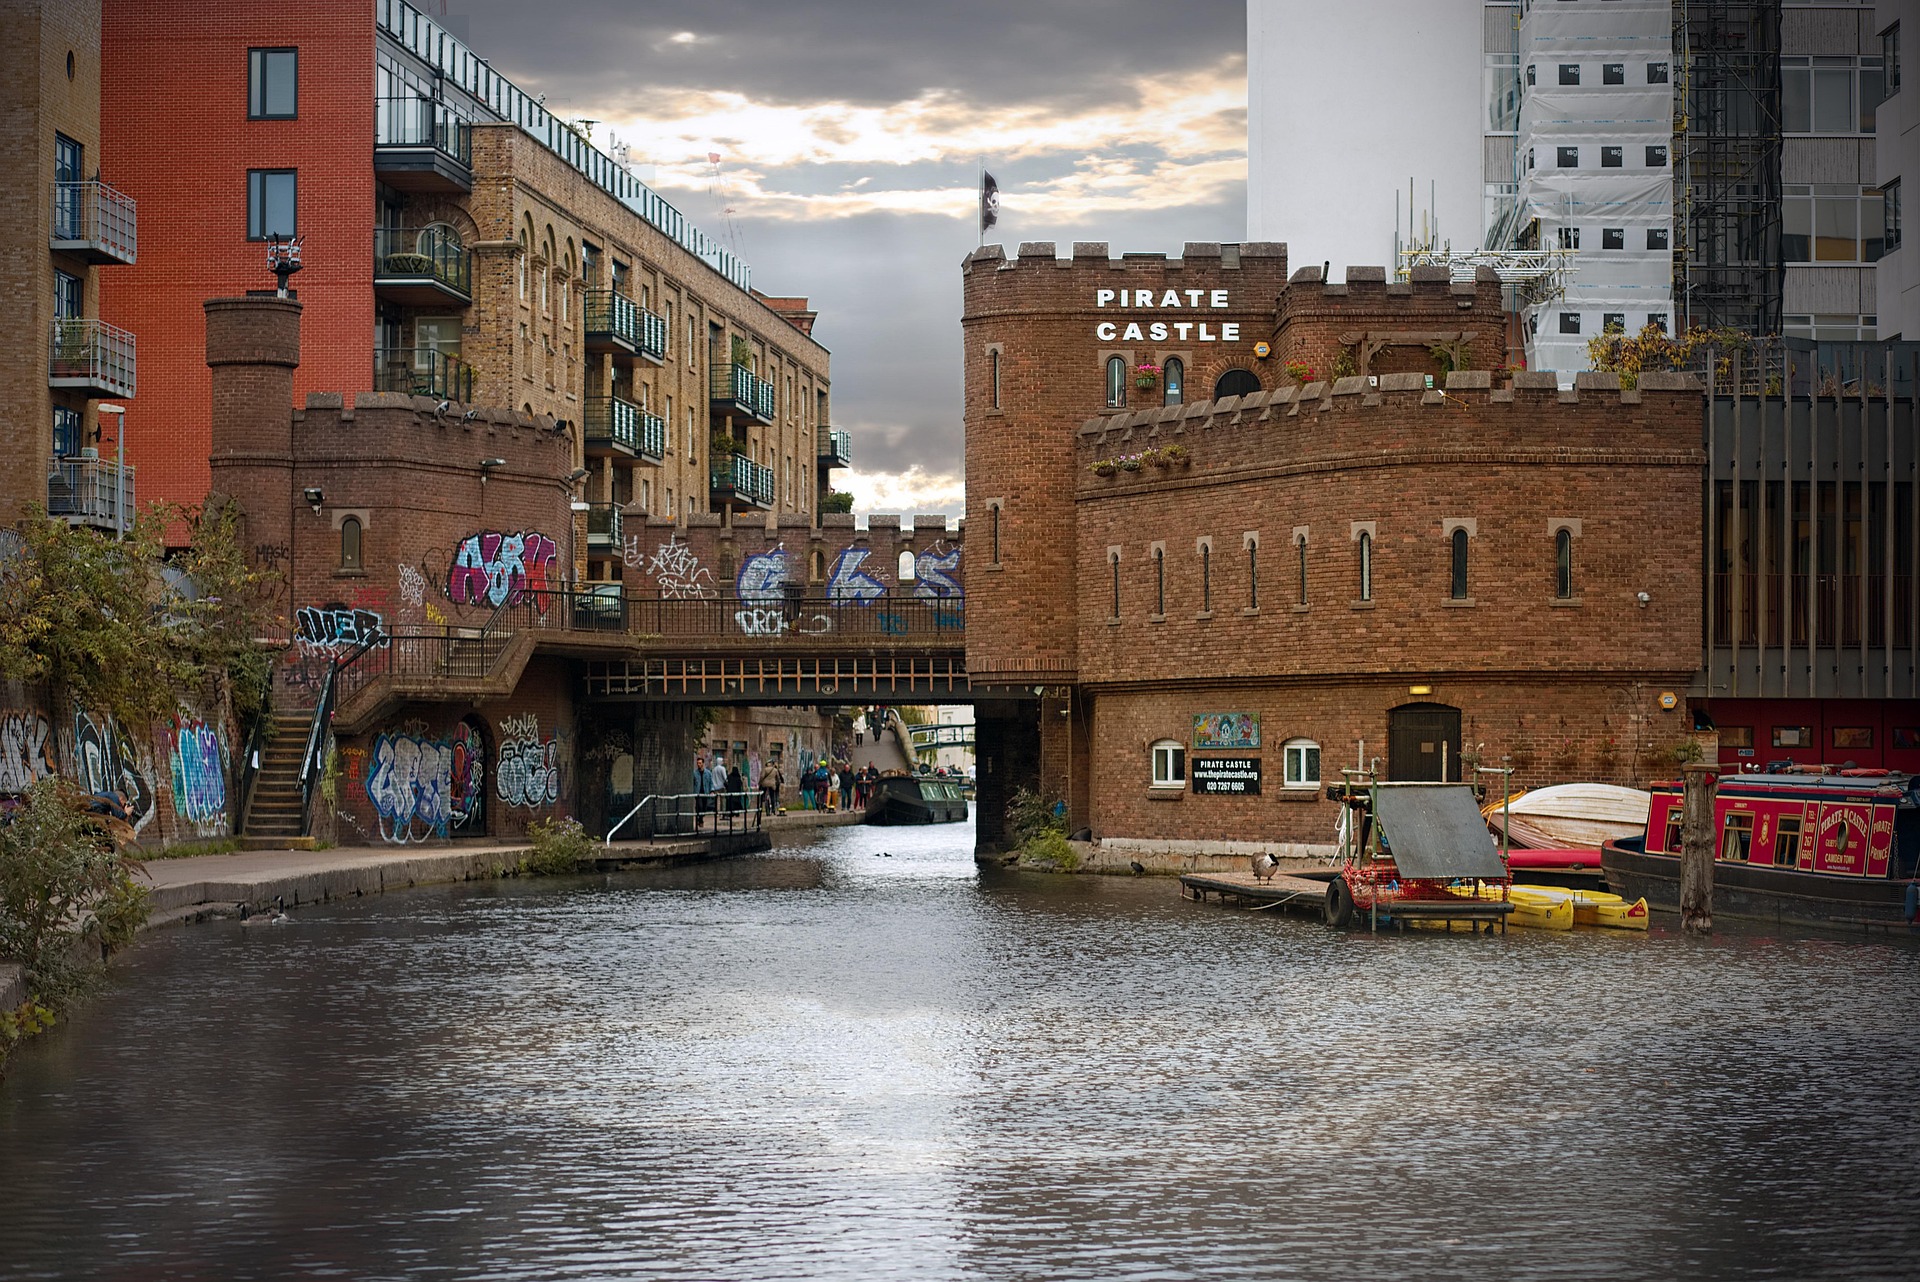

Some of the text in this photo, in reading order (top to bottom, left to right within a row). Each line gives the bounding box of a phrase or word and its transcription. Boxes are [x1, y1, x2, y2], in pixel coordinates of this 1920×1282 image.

[1096, 289, 1229, 308] PIRATE
[1096, 322, 1240, 341] CASTLE
[1200, 760, 1251, 768] PIRATE CASTLE
[1194, 770, 1258, 781] www.thepiratecastle.org
[1206, 781, 1217, 791] 020
[1820, 809, 1868, 838] PIRATE CASTLE
[1873, 820, 1892, 835] PIRATE
[1870, 844, 1890, 861] PRINCE
